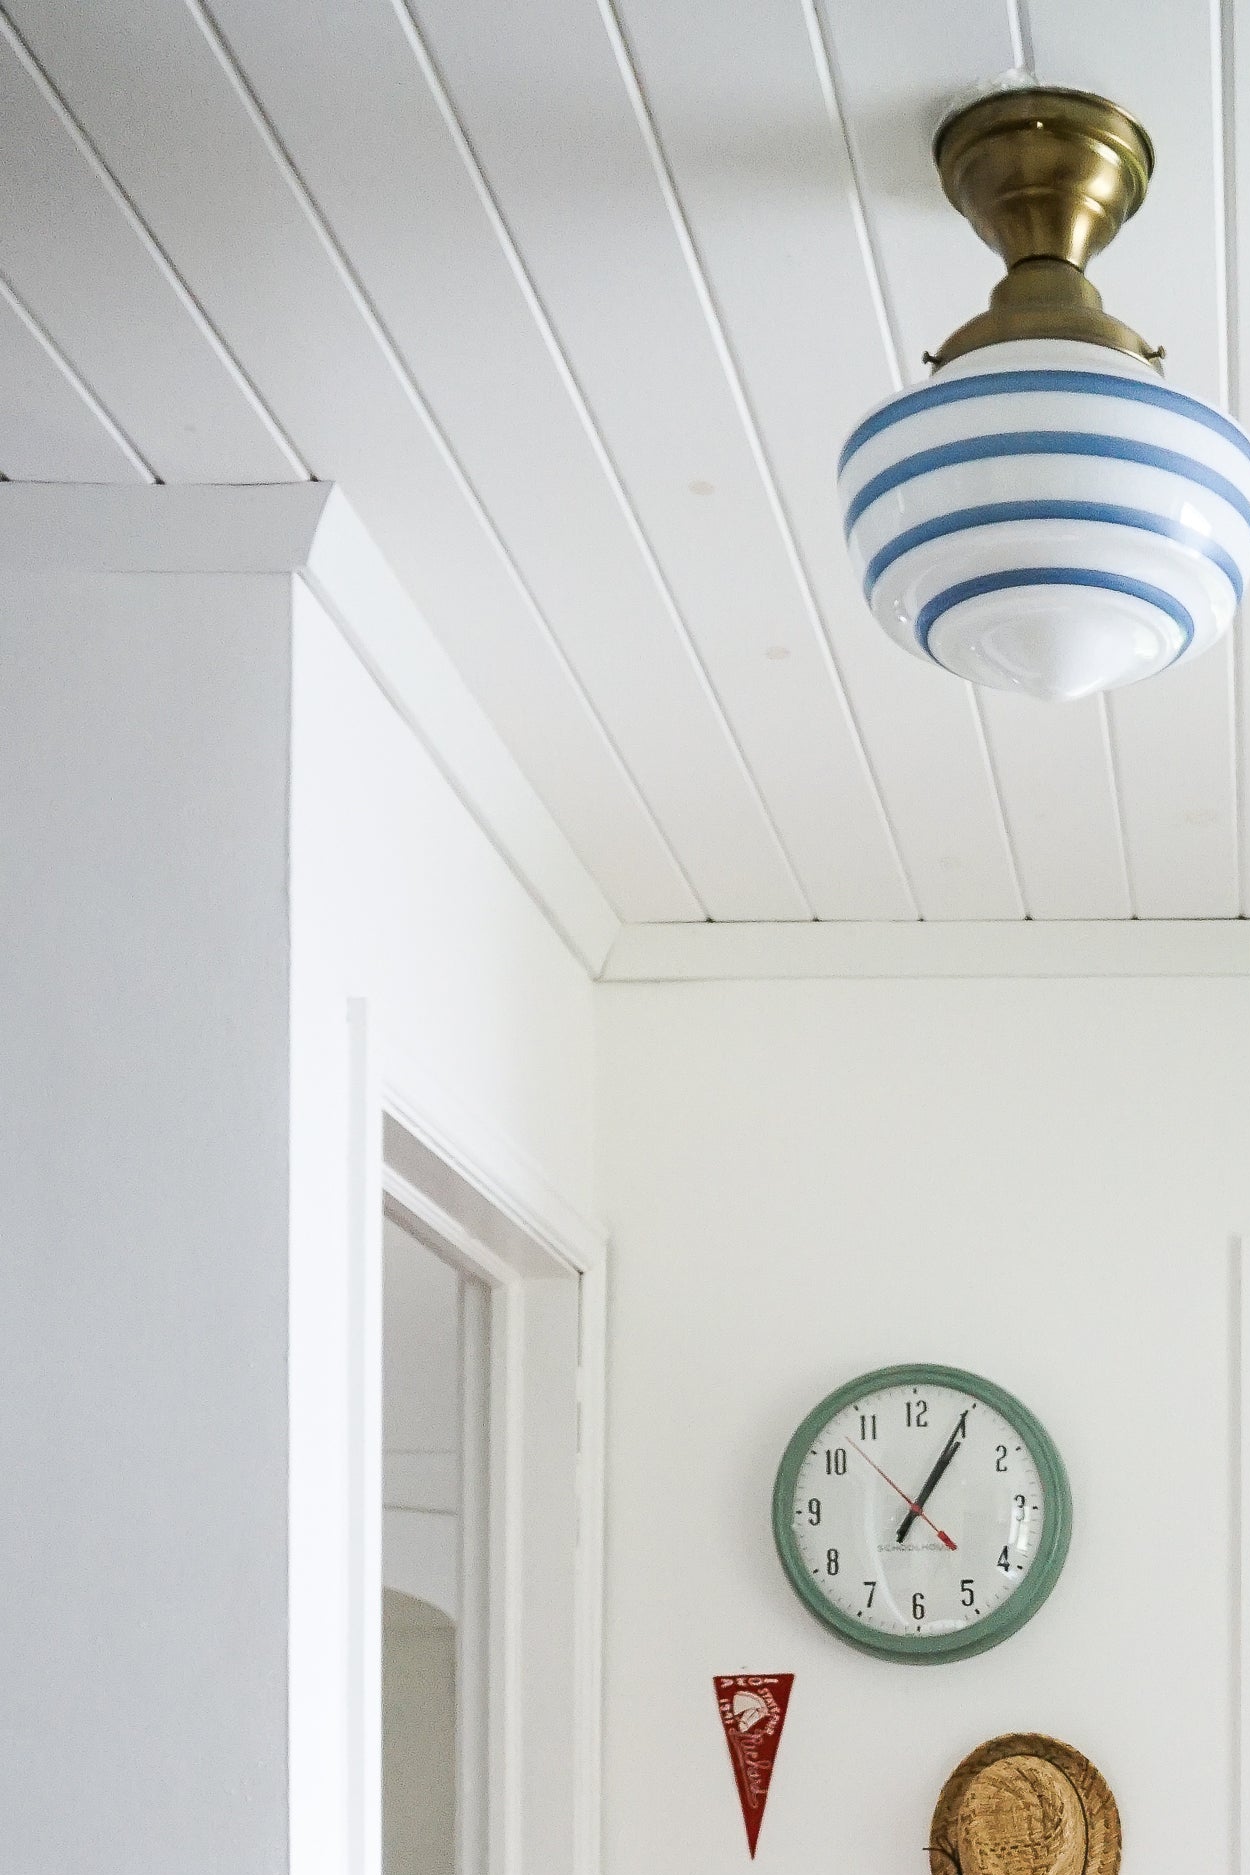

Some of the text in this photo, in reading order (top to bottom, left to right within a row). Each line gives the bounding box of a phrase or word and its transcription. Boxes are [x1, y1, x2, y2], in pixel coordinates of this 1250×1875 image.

[860, 1414, 877, 1440] 11
[906, 1400, 928, 1428] 12
[825, 1448, 847, 1475] 10
[995, 1445, 1008, 1472] 2
[808, 1497, 821, 1526] 9
[1014, 1494, 1025, 1522] 3
[826, 1548, 839, 1576] 8
[997, 1545, 1010, 1572] 4
[863, 1581, 876, 1608] 7
[912, 1592, 925, 1620] 6
[960, 1579, 974, 1607] 5
[720, 1677, 779, 1688] IOWA
